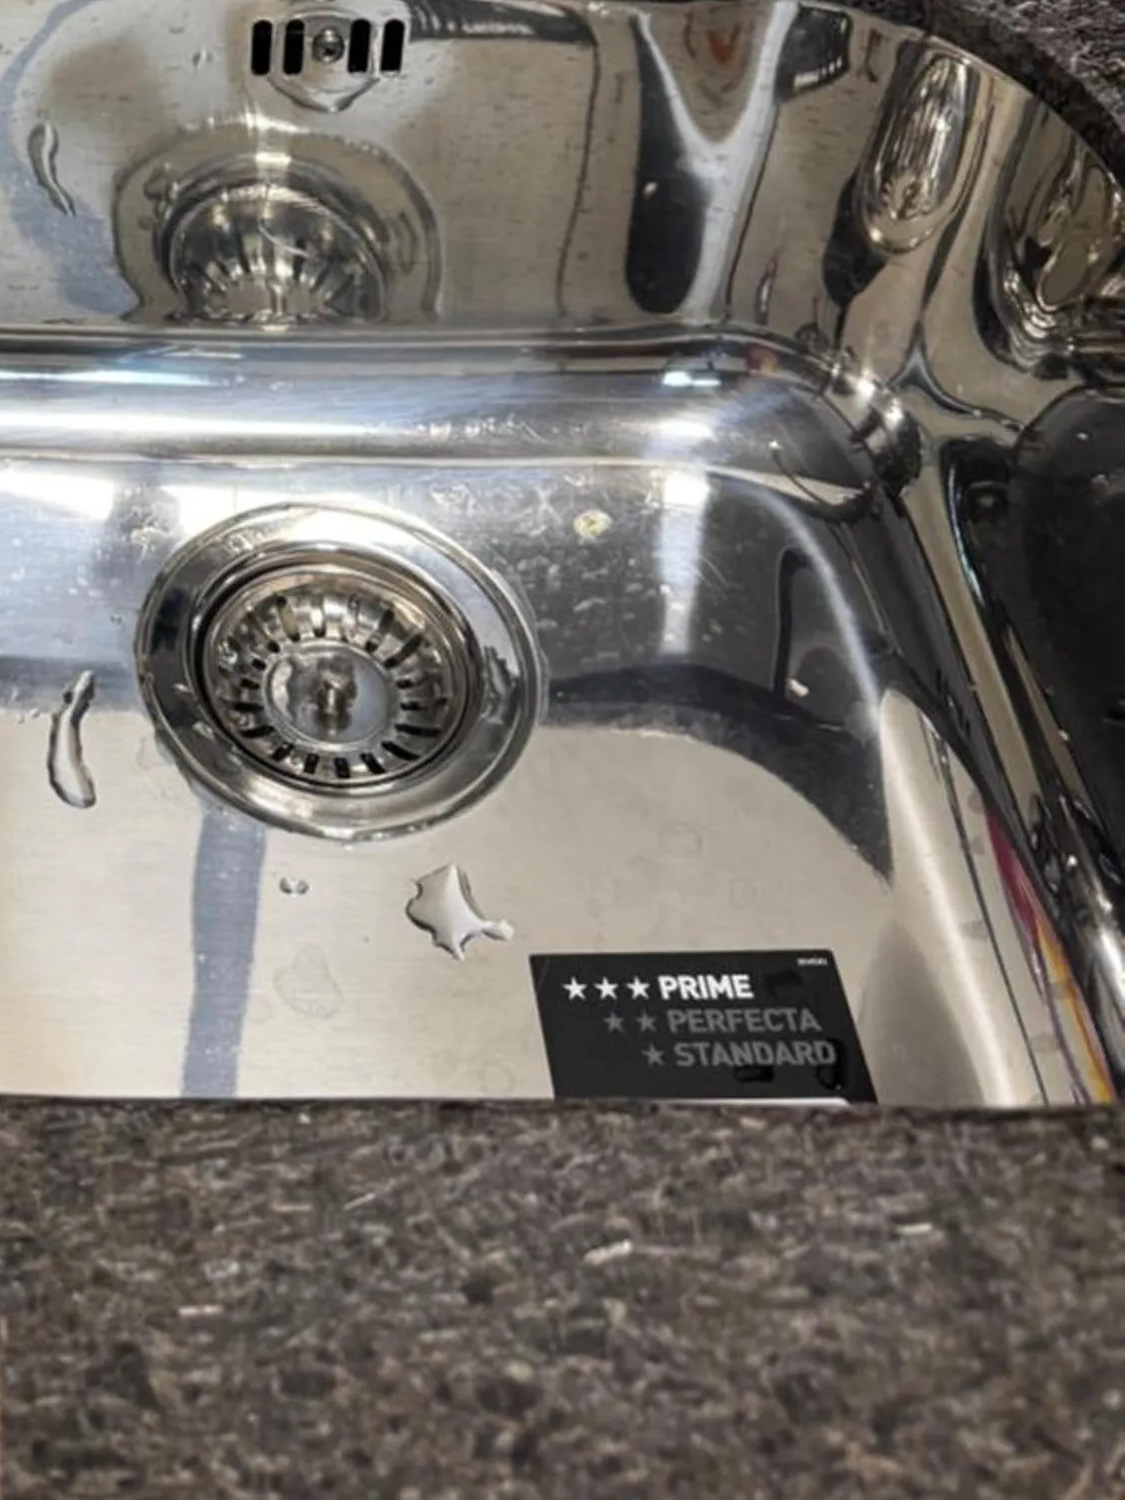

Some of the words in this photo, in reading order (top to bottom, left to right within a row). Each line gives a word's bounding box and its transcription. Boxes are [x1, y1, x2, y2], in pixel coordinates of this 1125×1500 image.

[659, 975, 754, 999] PRIME
[667, 1008, 822, 1033] PERFECTA
[674, 1041, 837, 1066] STANDARD
